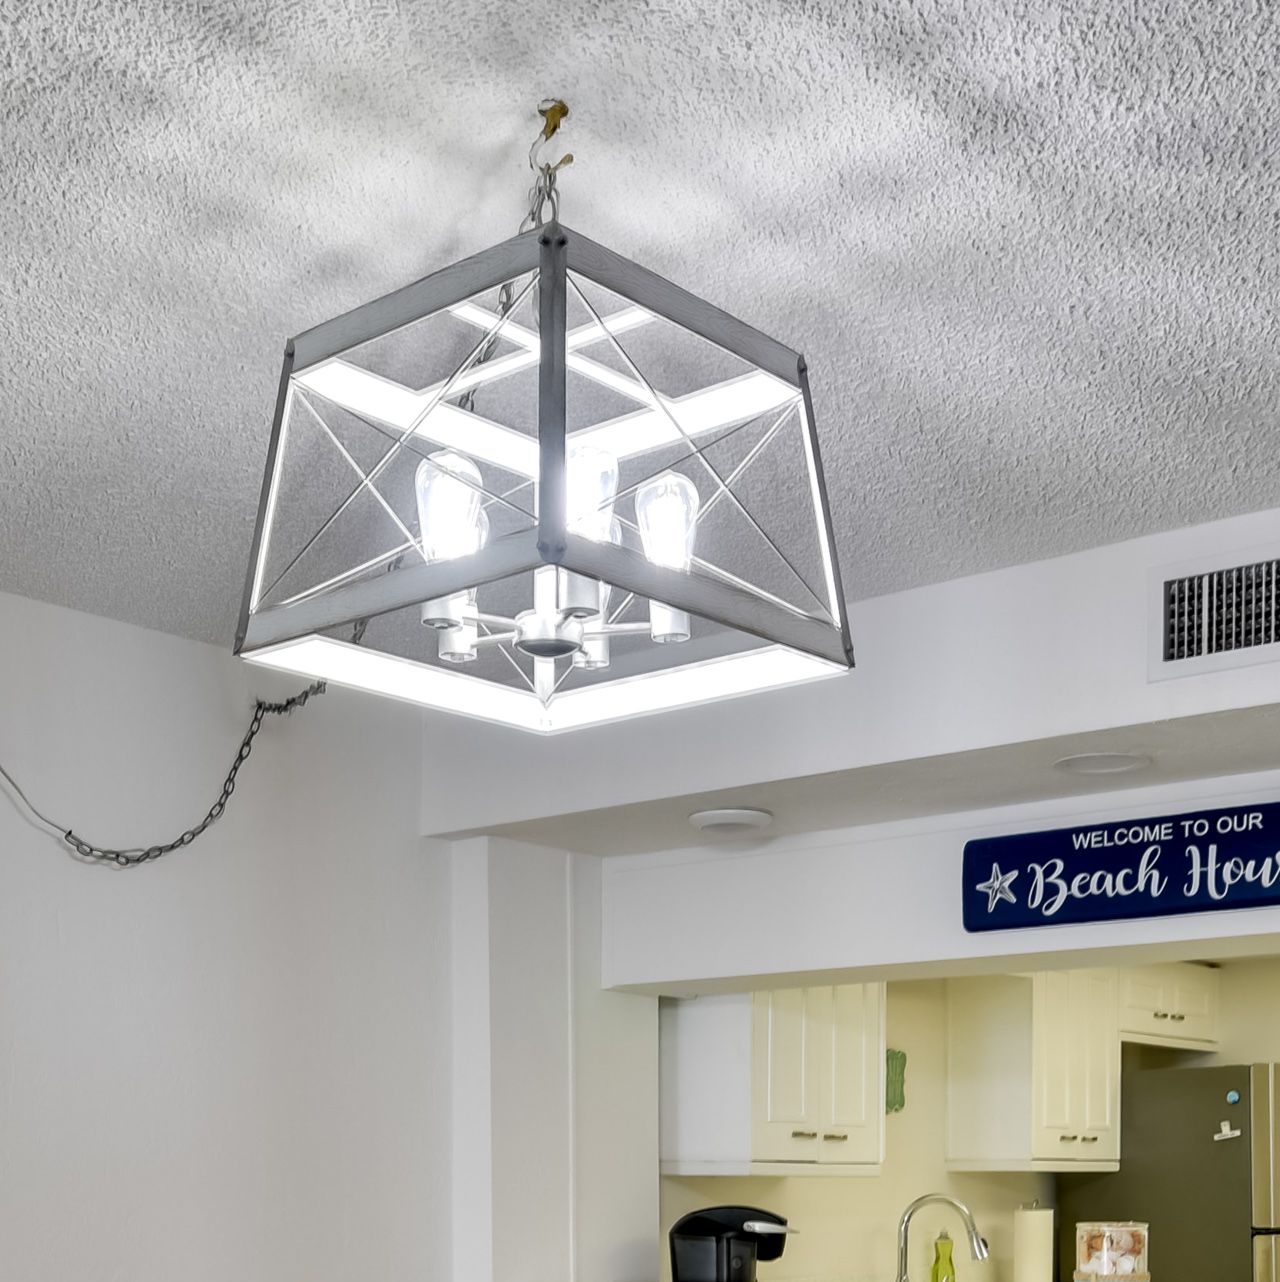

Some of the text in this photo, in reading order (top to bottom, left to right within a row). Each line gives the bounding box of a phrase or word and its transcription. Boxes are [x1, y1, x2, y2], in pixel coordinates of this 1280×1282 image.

[1072, 812, 1263, 850] WELCOME TO OUR
[1027, 845, 1168, 916] Beach
